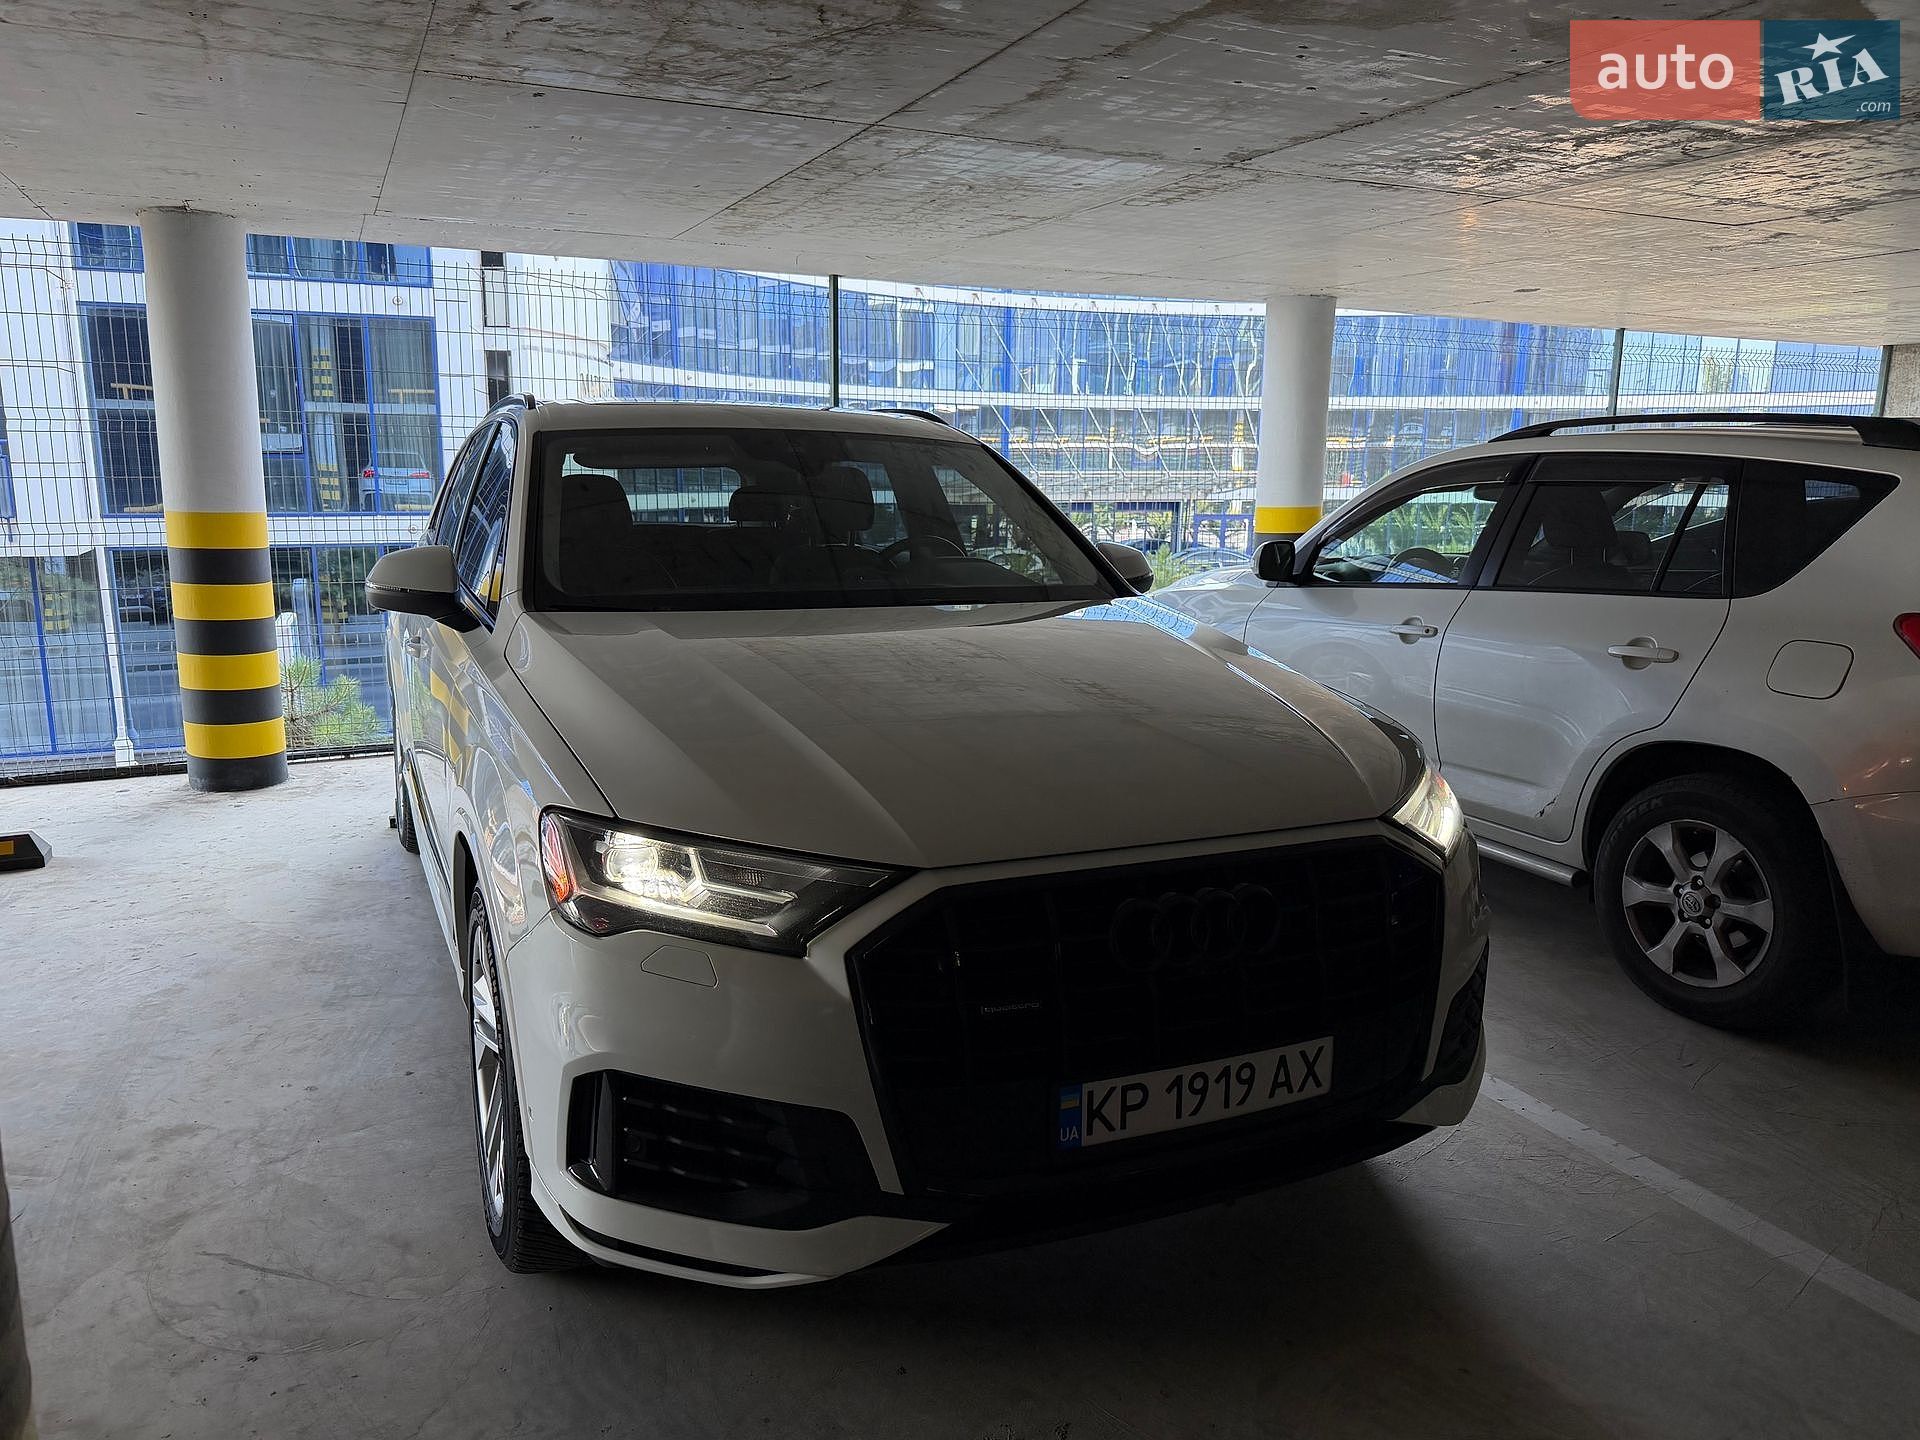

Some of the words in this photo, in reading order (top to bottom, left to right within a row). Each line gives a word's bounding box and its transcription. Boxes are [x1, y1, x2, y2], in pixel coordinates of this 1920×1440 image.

[1085, 1081, 1150, 1137] KP
[1165, 1061, 1256, 1120] 1919
[1268, 1045, 1325, 1099] AX
[1059, 1126, 1080, 1142] UA
